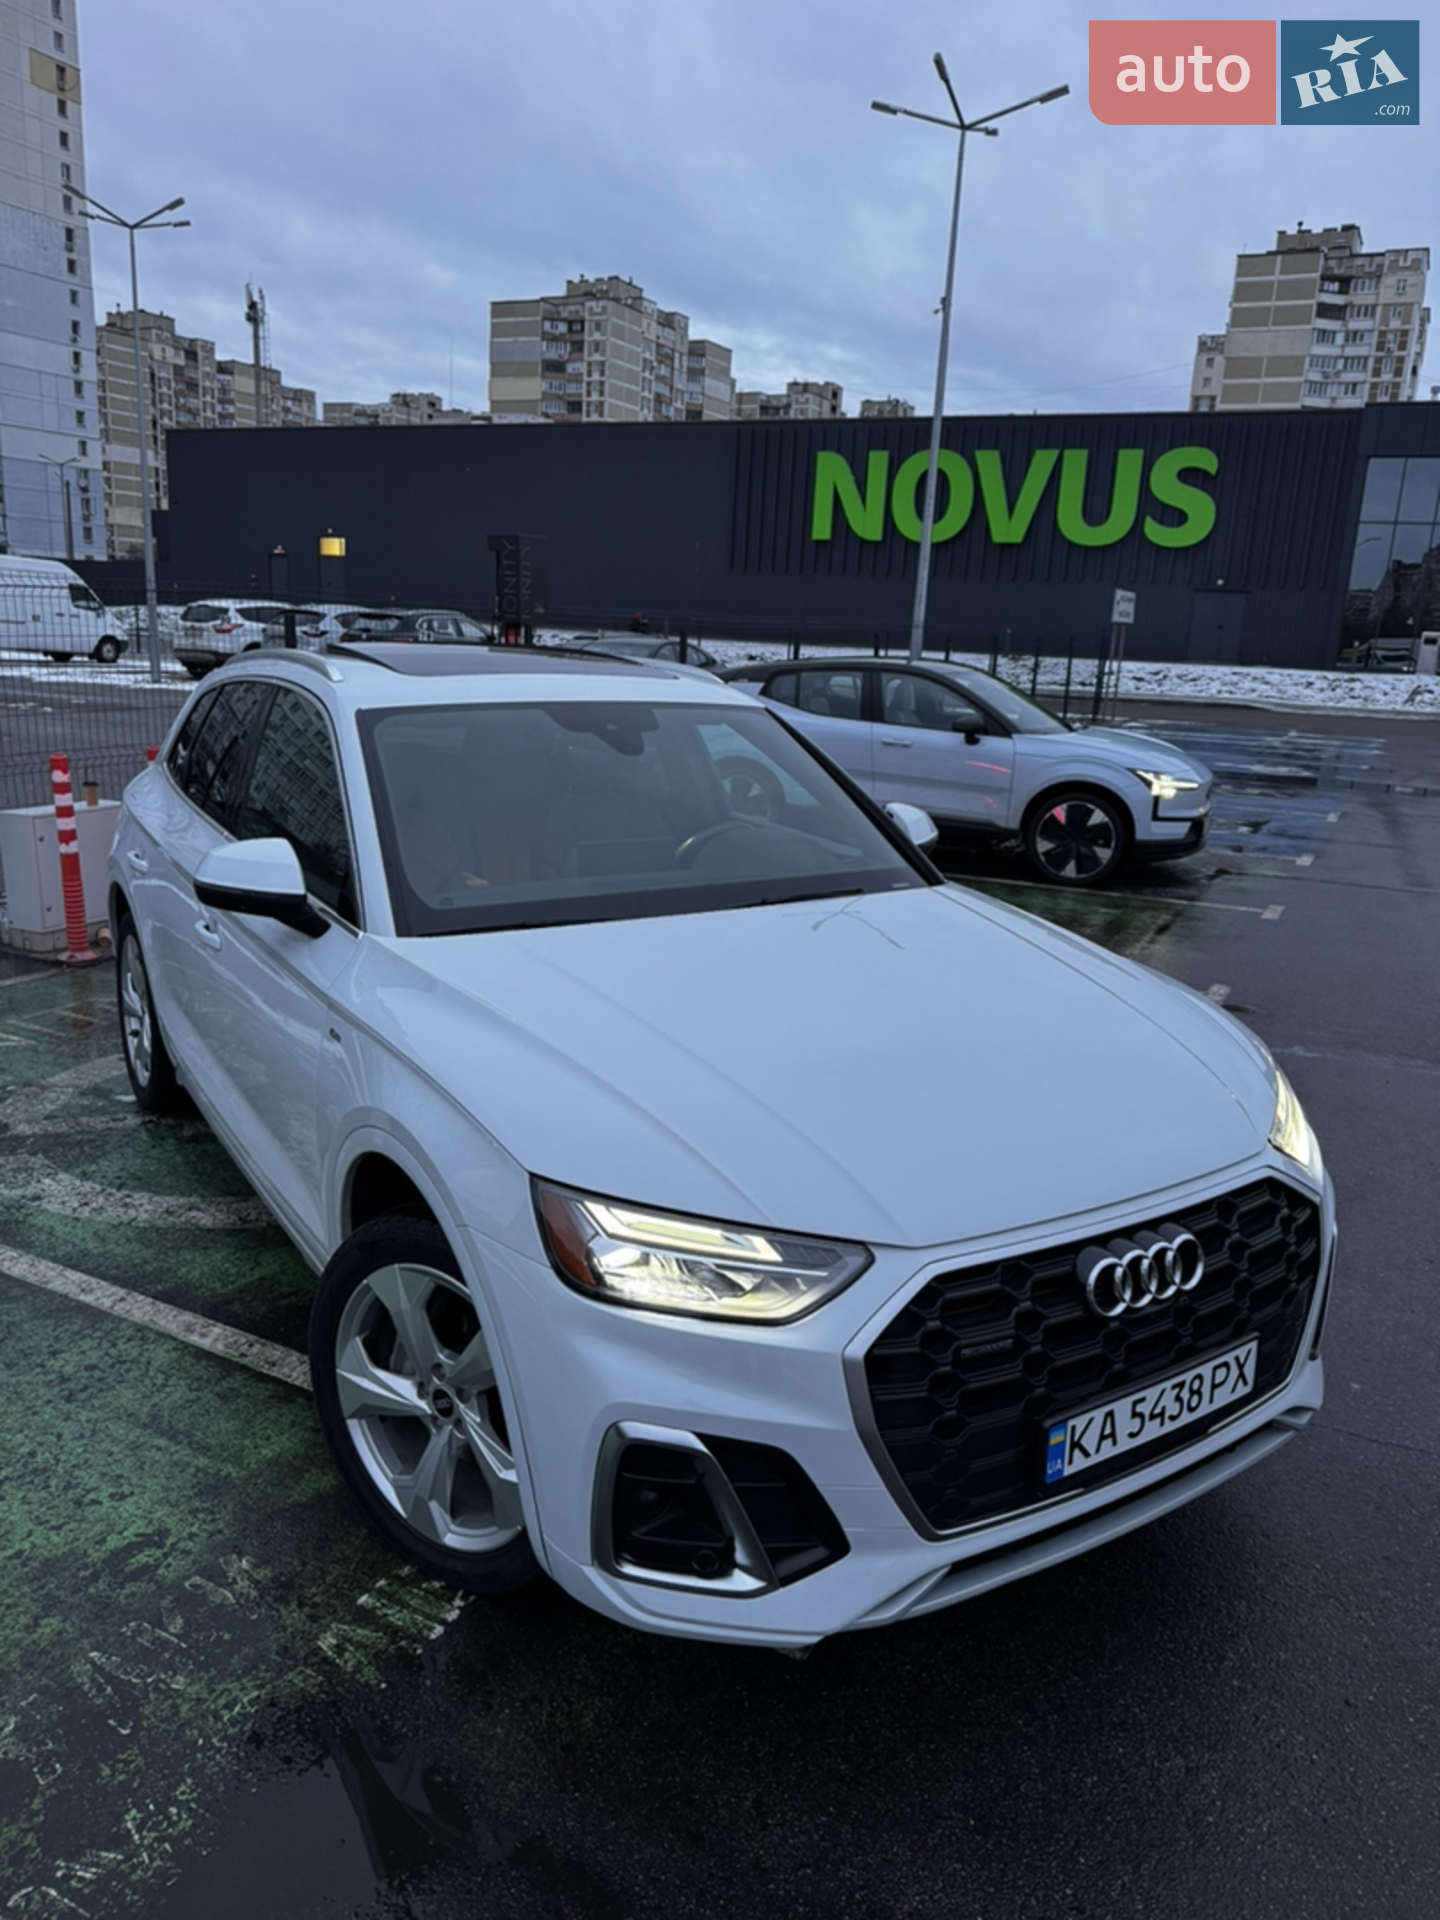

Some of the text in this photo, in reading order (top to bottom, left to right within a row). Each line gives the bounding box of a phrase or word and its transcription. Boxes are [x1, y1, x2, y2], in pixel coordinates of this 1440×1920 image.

[811, 445, 1219, 548] NOVUS
[502, 539, 518, 618] IONITY
[1067, 1347, 1253, 1466] KA 5438 PX
[1046, 1457, 1063, 1475] UA
